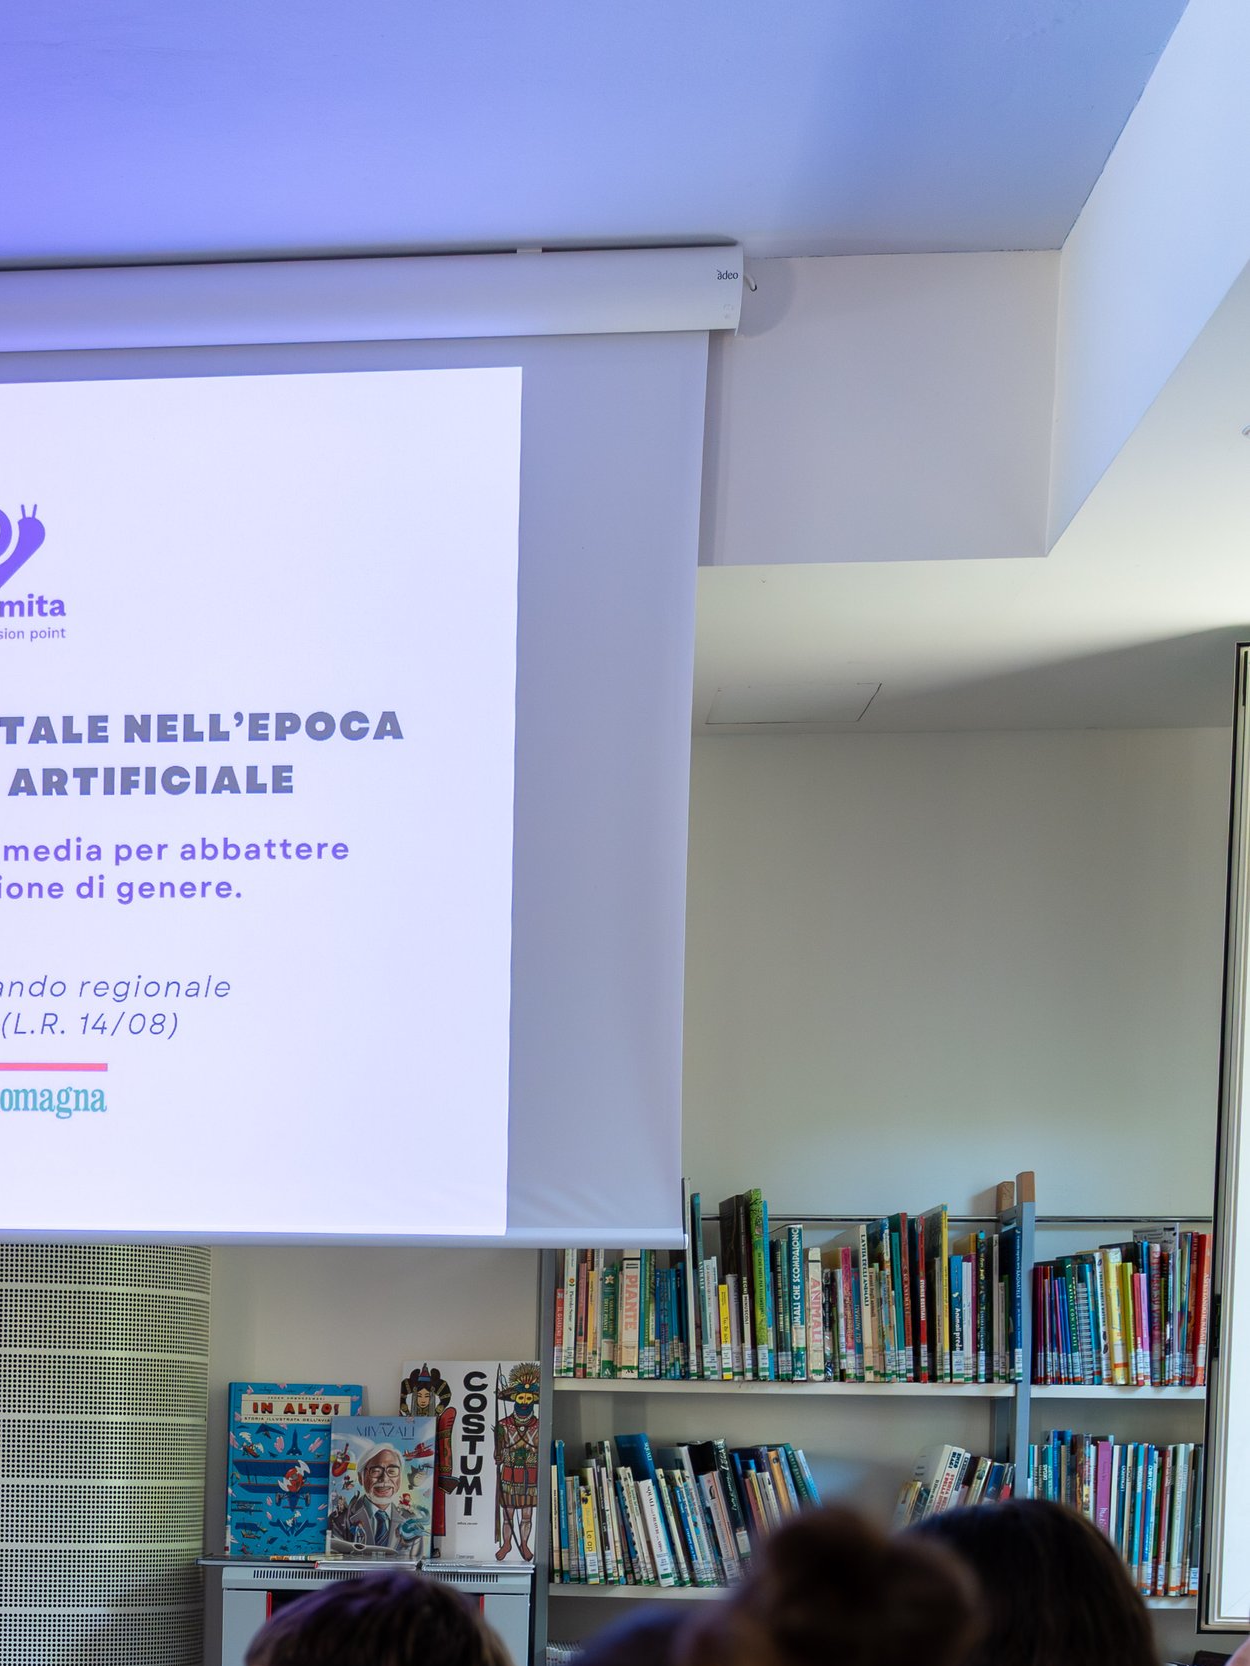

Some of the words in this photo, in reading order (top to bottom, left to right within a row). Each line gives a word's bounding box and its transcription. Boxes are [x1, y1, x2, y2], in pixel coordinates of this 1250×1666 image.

[30, 627, 65, 642] point
[124, 711, 404, 743] NELL’EPOCA
[8, 765, 293, 796] ARTIFICIALE
[4, 837, 101, 862] media
[115, 844, 168, 866] per
[180, 837, 349, 860] abbattere
[76, 874, 104, 899] di
[117, 881, 241, 905] genere.
[79, 975, 230, 1002] regionale
[2, 1012, 64, 1039] (L.R.
[81, 1012, 177, 1039] 14/08)
[625, 1274, 639, 1330] PIANTE
[792, 1284, 801, 1300] CHE
[810, 1277, 822, 1344] ANIMALI
[954, 1307, 962, 1332] Animali
[252, 1402, 273, 1414] IN
[283, 1402, 339, 1415] ALTO!
[456, 1371, 488, 1516] COSTUMI
[947, 1451, 957, 1469] BIAGI
[953, 1453, 962, 1469] ENZO
[645, 1485, 655, 1508] SQUALI
[944, 1474, 955, 1495] STORIA
